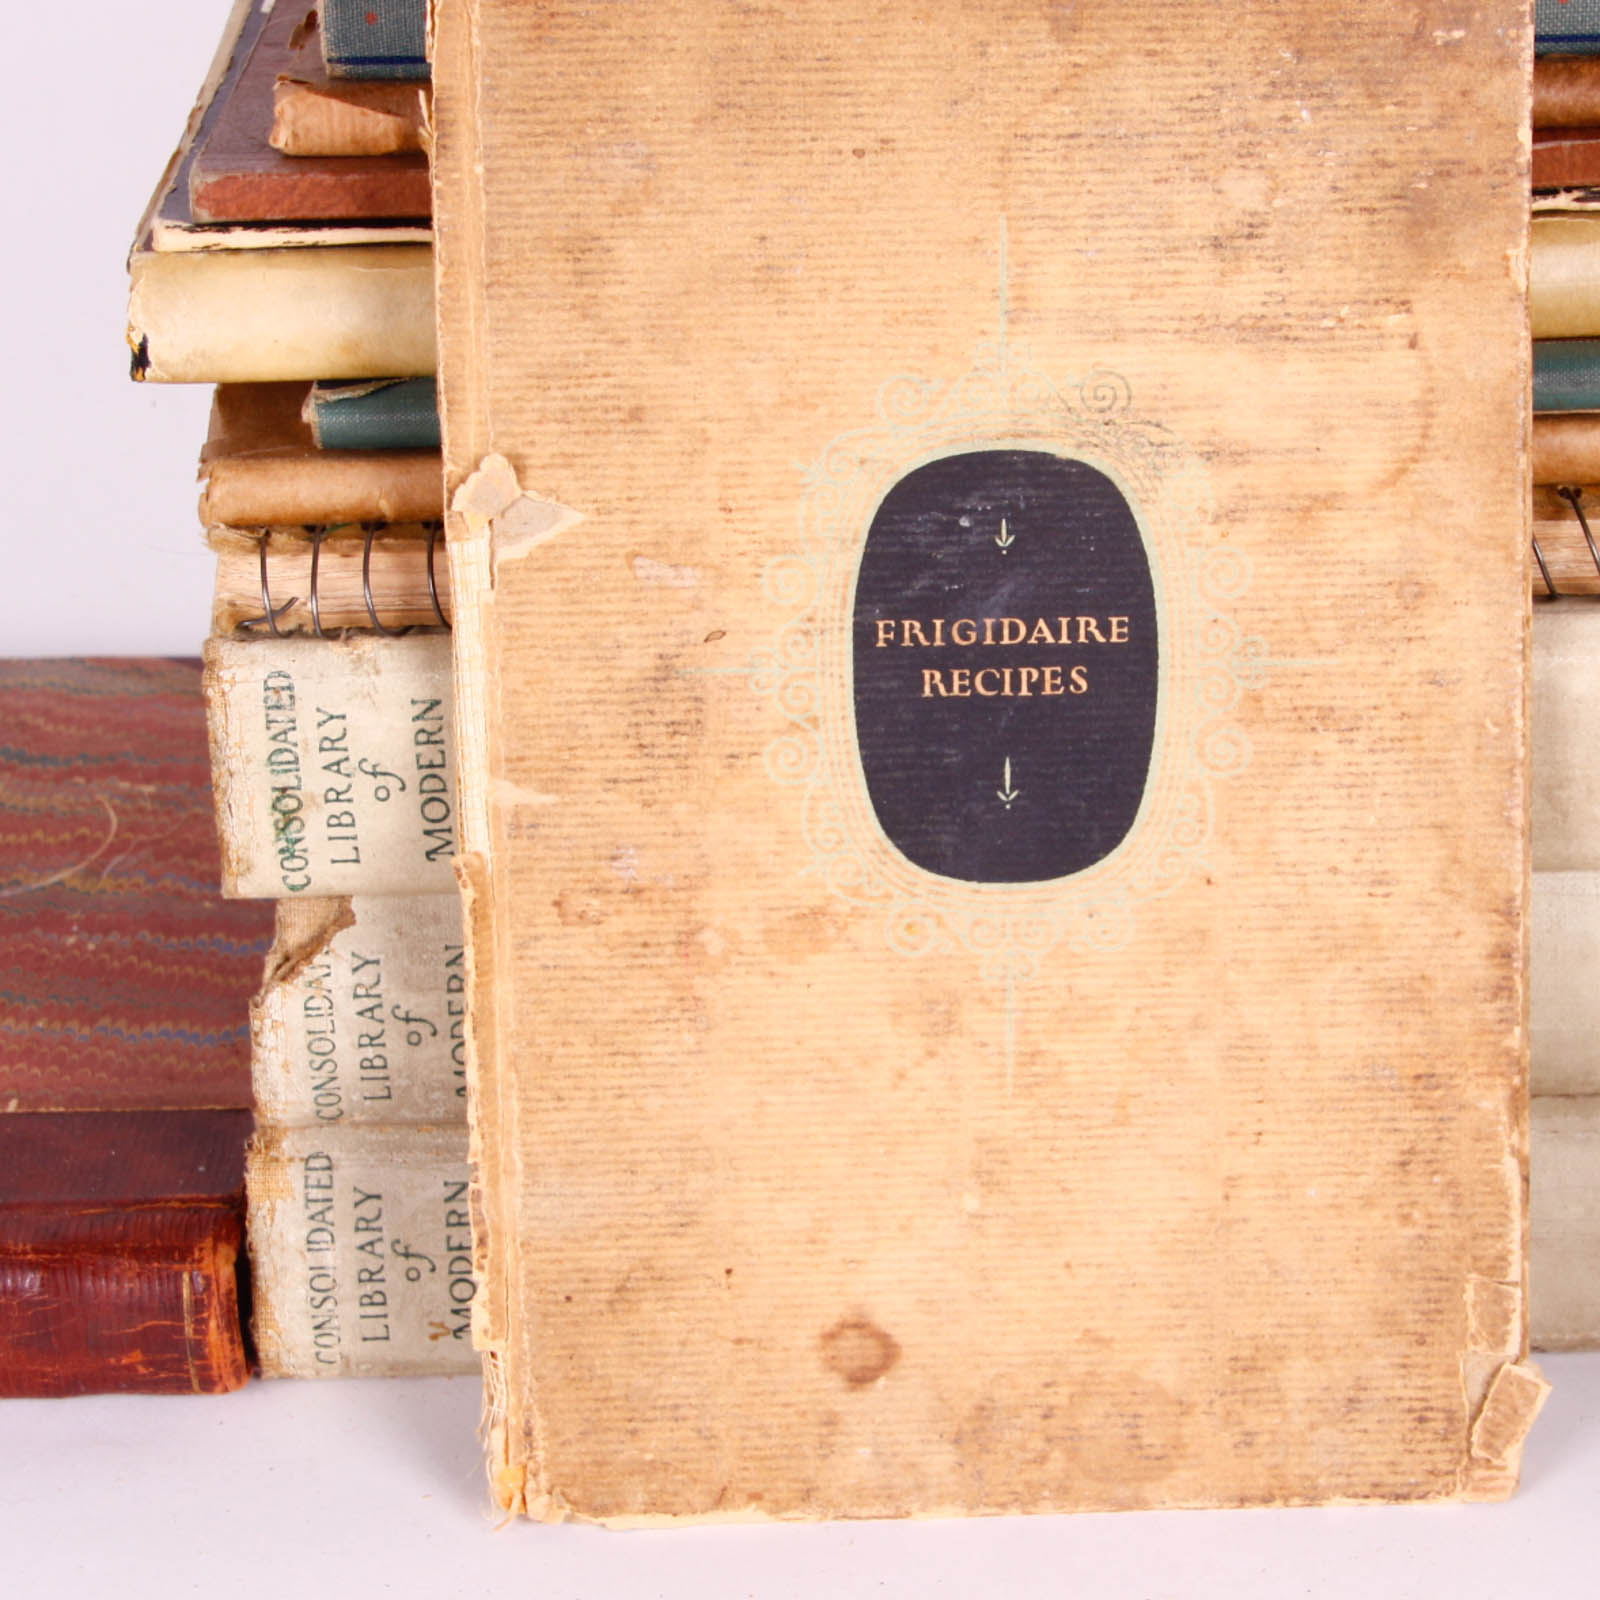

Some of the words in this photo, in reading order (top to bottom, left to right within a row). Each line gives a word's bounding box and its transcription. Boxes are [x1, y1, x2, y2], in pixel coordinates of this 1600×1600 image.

[875, 616, 1130, 648] FRIGIDAIRE
[921, 665, 1089, 698] RECIPES
[263, 670, 311, 892] CONSOLIDATED
[316, 707, 361, 864] LIBRARY
[358, 758, 406, 802] of
[410, 698, 454, 862] MODERN
[304, 949, 344, 1121] CONSOLIDA
[351, 951, 392, 1101] LIBRARY
[391, 1004, 438, 1046] of
[352, 1186, 391, 1342] LIBRARY
[391, 1239, 436, 1282] of
[443, 1180, 477, 1340] MODERN
